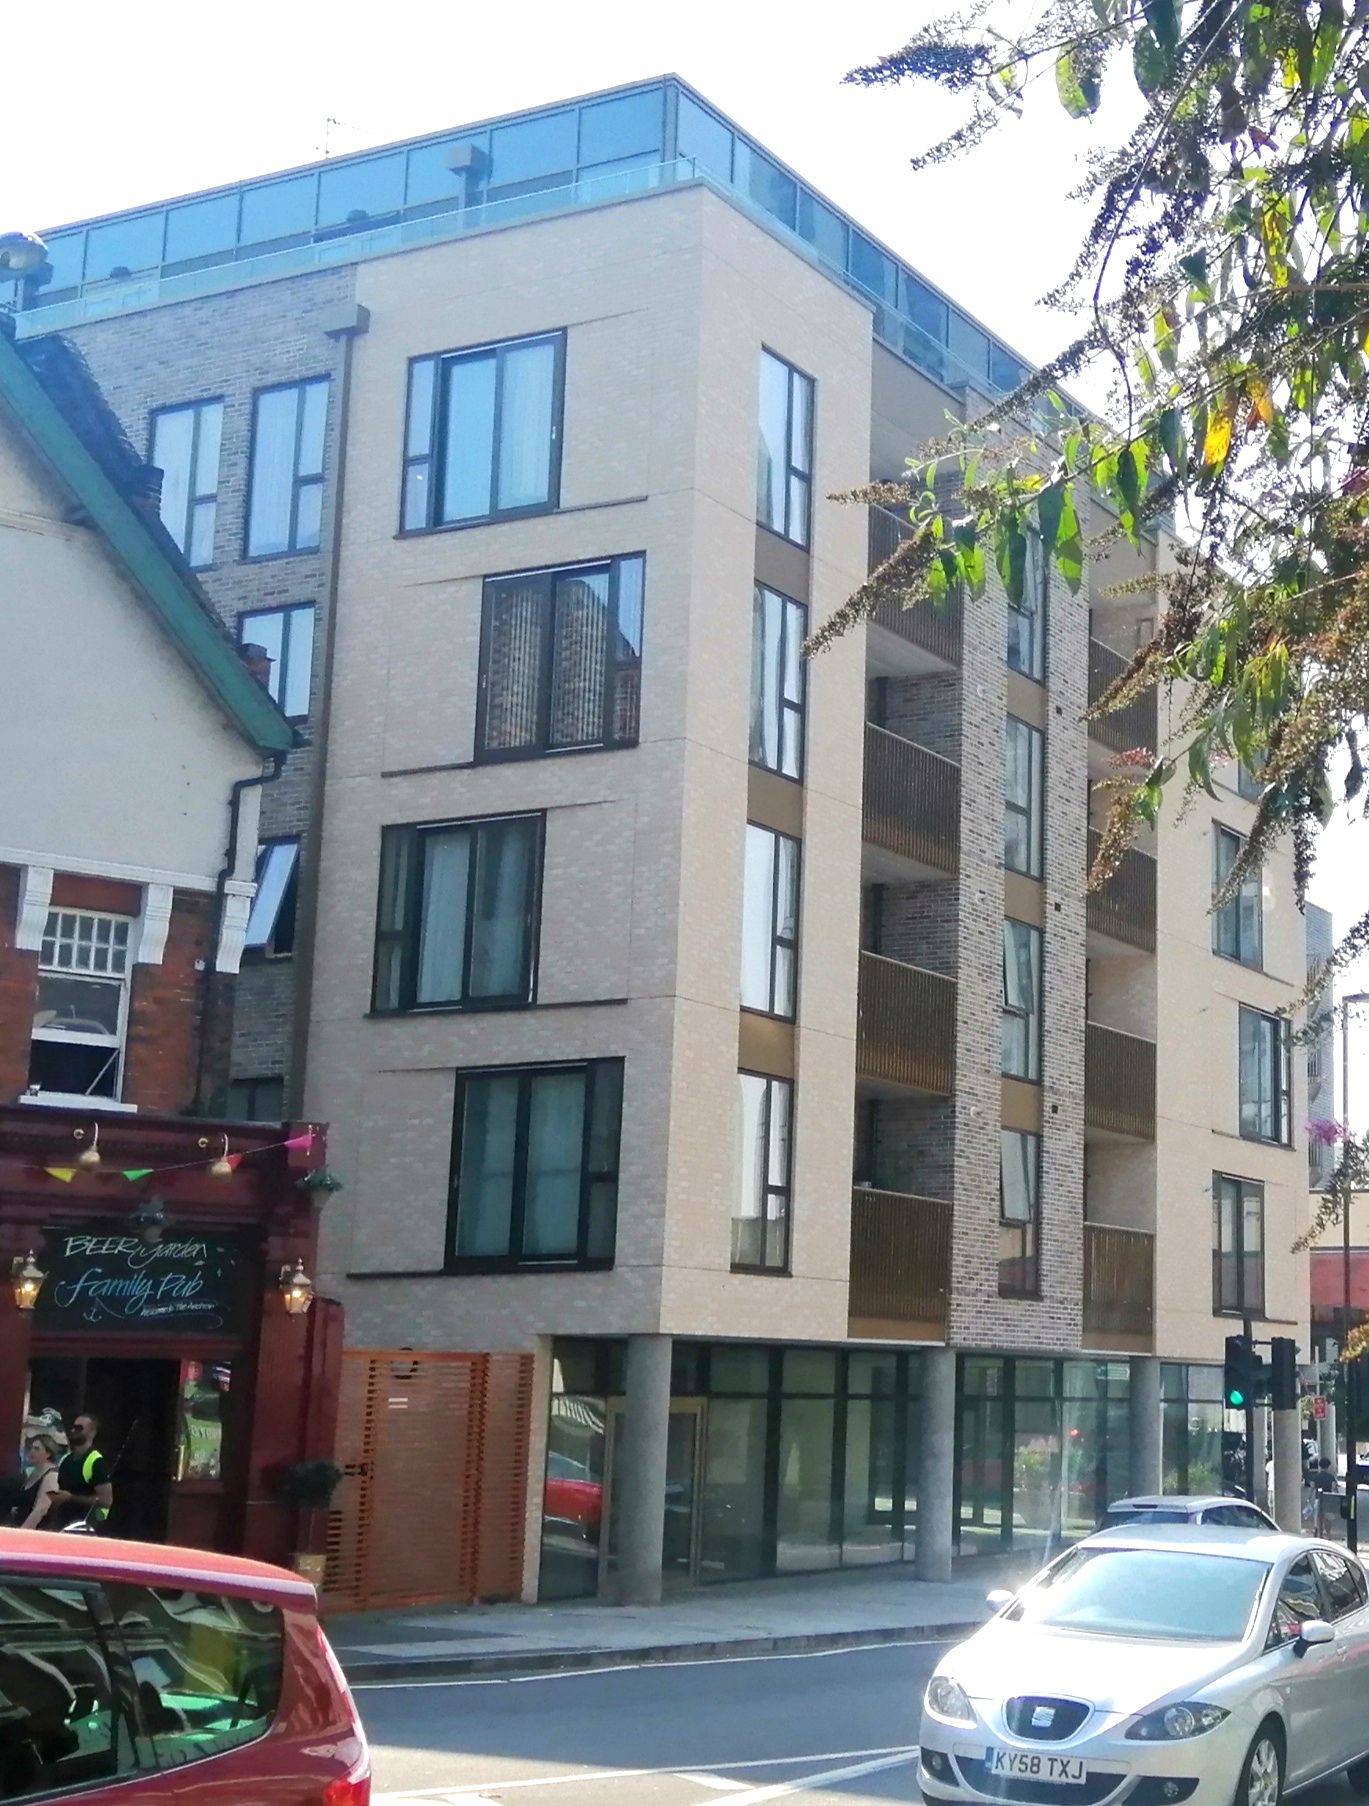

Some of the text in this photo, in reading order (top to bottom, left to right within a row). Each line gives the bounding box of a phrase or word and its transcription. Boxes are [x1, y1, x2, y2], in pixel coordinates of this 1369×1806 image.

[64, 1235, 207, 1269] BEER garden
[156, 1272, 203, 1300] Pub
[995, 1751, 1084, 1779] KY58 TXJ
